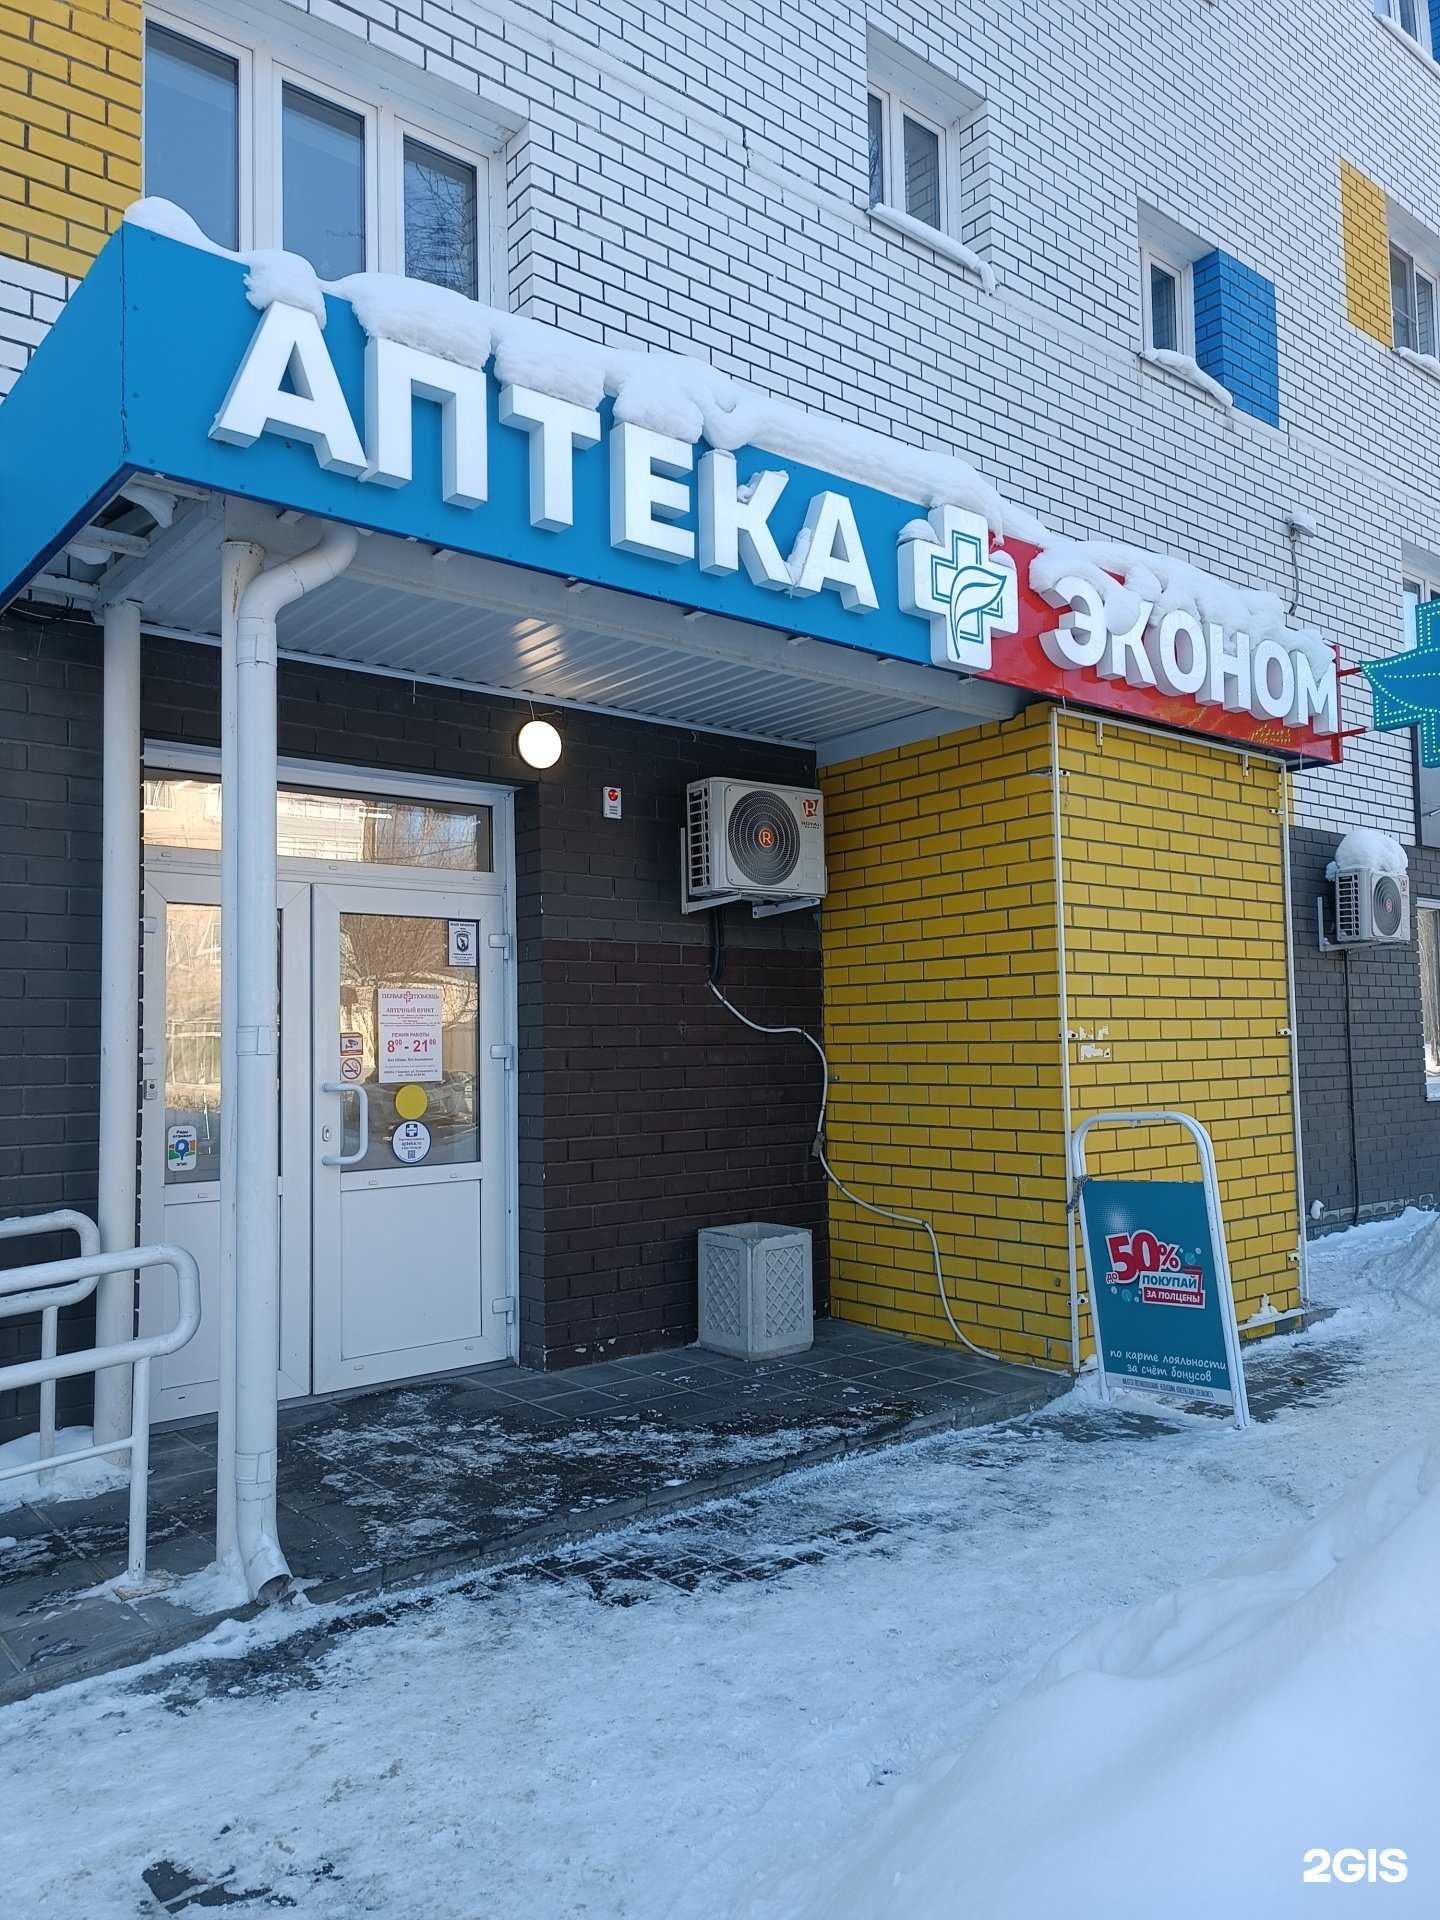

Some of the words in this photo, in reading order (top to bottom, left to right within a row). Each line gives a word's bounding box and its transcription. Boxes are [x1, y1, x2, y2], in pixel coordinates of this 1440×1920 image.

[209, 300, 880, 614] АПТЕКА
[1040, 576, 1338, 736] ЭКОНОМ
[1105, 1230, 1180, 1283] 50%
[1142, 1274, 1197, 1289] ПОКУПАЙ
[1146, 1290, 1157, 1298] ЗА
[1158, 1292, 1201, 1303] ПОЛЦЕНЫ
[1110, 1350, 1122, 1358] по
[1125, 1351, 1159, 1364] карте
[1162, 1355, 1227, 1370] лояльности
[1127, 1364, 1138, 1373] за
[1171, 1367, 1212, 1382] бонусов
